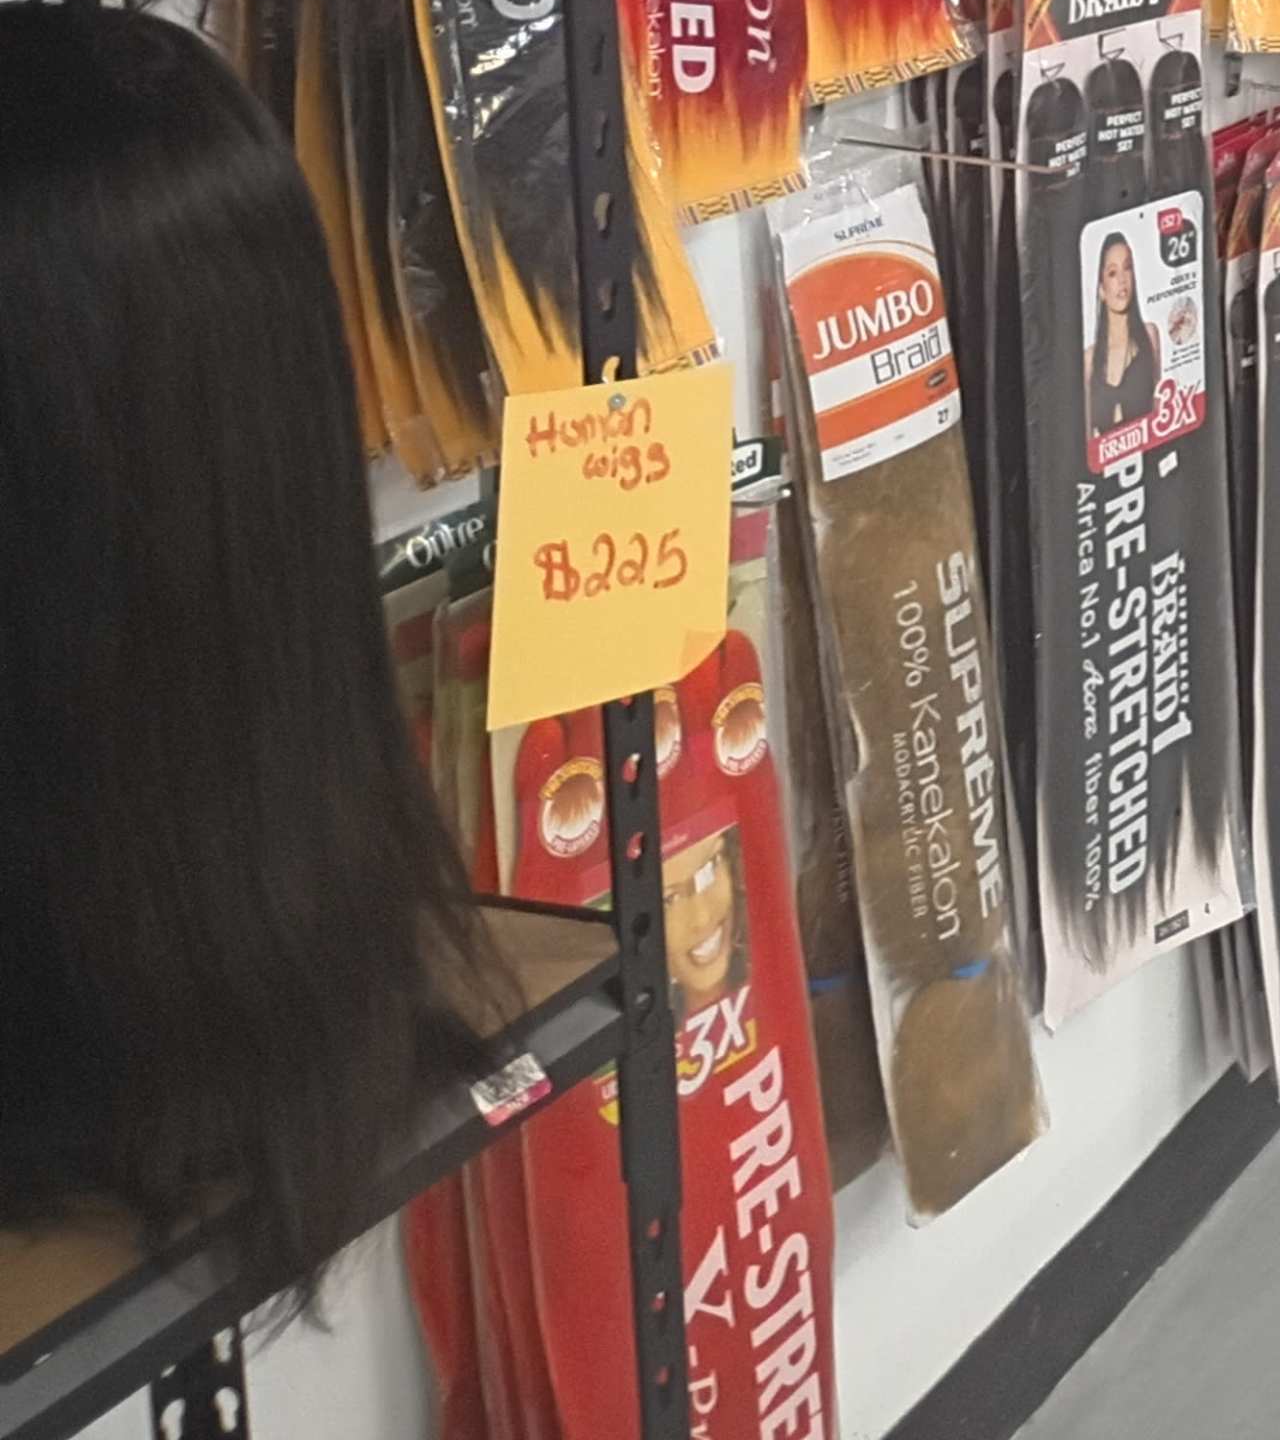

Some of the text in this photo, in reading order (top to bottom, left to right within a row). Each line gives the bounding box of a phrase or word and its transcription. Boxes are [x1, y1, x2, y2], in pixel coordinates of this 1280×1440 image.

[1171, 87, 1201, 105] PERFEC
[813, 278, 935, 360] JUMBO
[870, 326, 943, 385] Braid
[533, 528, 688, 603] $225
[1075, 481, 1095, 578] Africa
[1100, 451, 1150, 896] PRE-STRETCHED
[893, 579, 963, 941] 100% Kanekalon
[891, 731, 928, 921] MODACRYLIC FIBER
